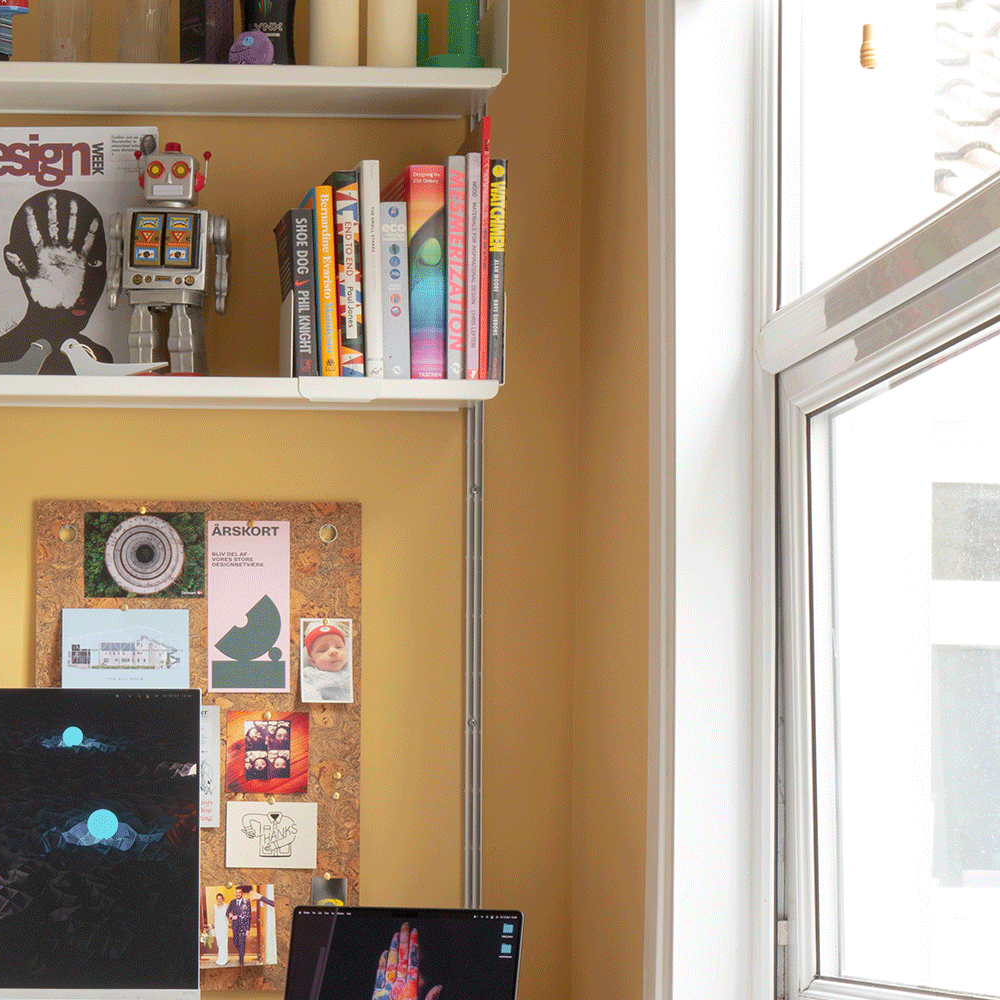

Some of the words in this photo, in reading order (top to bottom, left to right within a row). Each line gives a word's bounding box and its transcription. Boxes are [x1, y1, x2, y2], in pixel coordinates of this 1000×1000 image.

[91, 142, 104, 176] WEEK
[319, 193, 331, 253] Bernardine
[344, 220, 352, 240] END
[381, 223, 406, 233] eco
[489, 180, 506, 252] WATCHMEN
[295, 217, 309, 247] SHOE
[296, 249, 310, 275] DOG
[345, 242, 353, 256] TO
[448, 168, 465, 352] MESMERIZATION
[322, 255, 332, 299] Evaristo
[345, 257, 353, 277] END
[297, 289, 310, 314] PHIL
[298, 315, 312, 354] KNIGHT
[324, 301, 335, 354] Manifesto
[211, 523, 280, 537] ÅRSKORT
